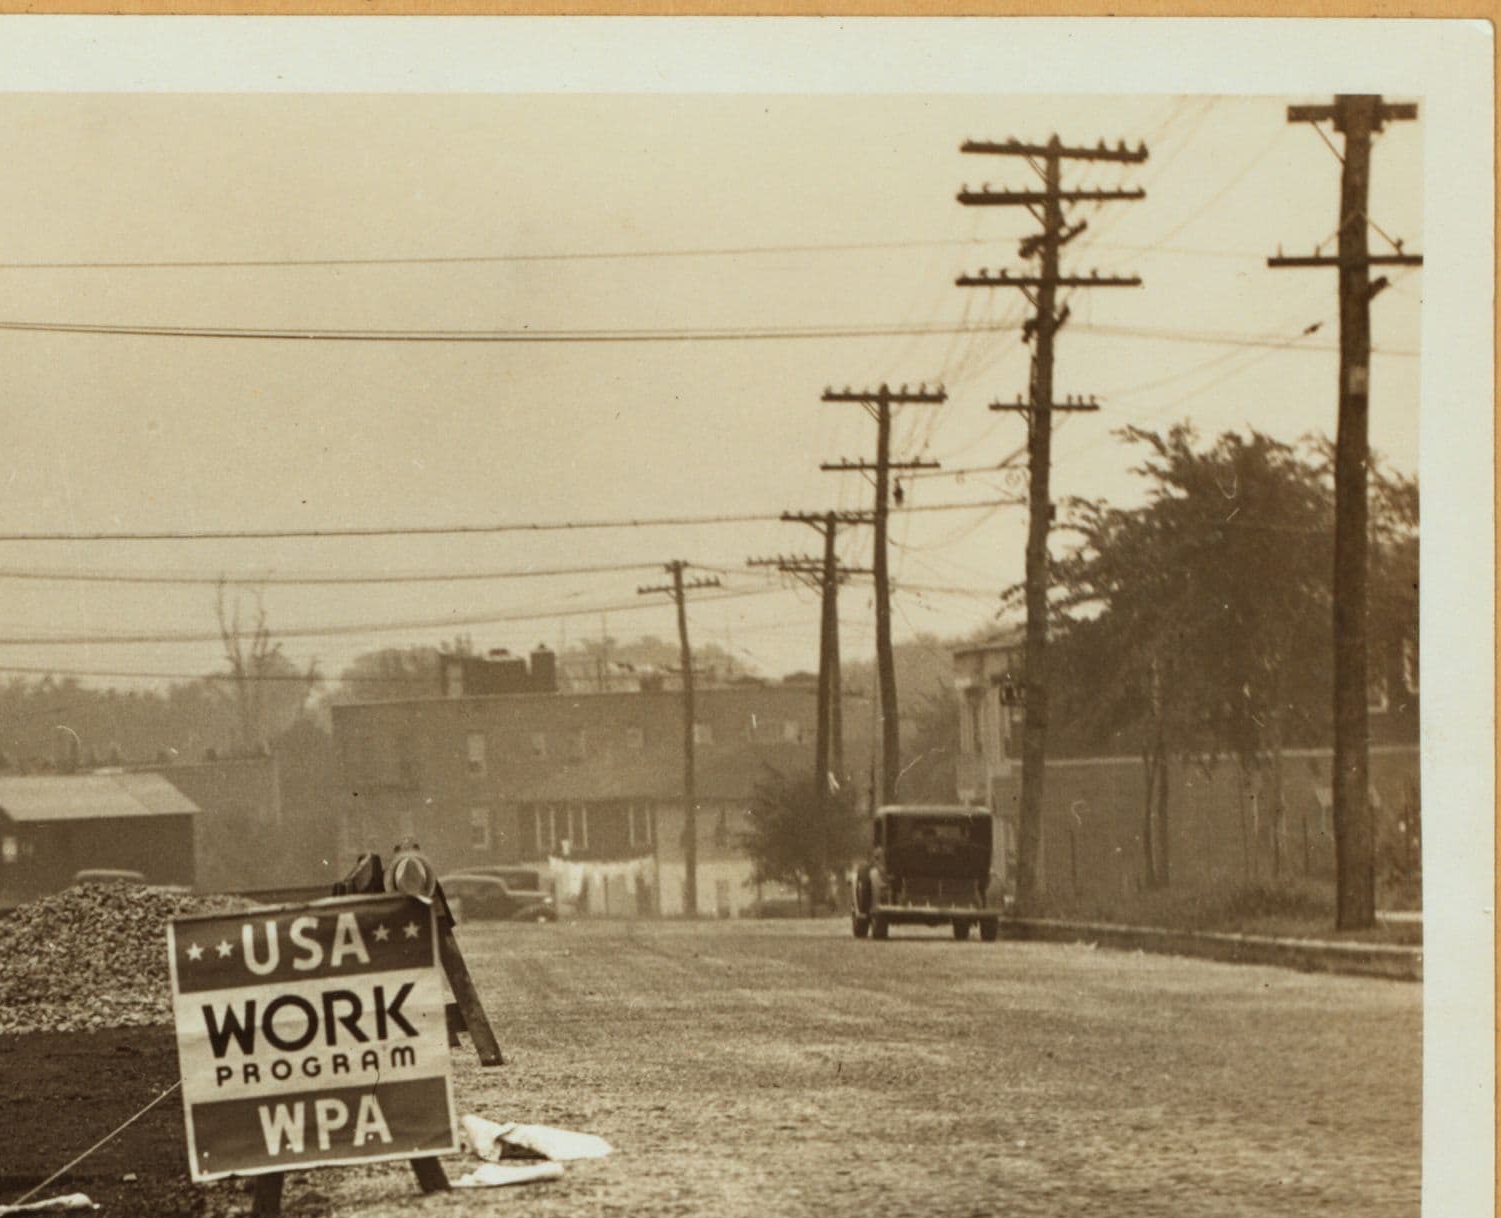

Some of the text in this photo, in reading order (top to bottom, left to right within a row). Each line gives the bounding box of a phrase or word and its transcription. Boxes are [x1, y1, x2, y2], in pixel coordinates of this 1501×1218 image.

[242, 912, 370, 976] USA
[202, 982, 419, 1059] WORK
[216, 1045, 415, 1087] PROGRAM
[258, 1094, 392, 1156] WPA
